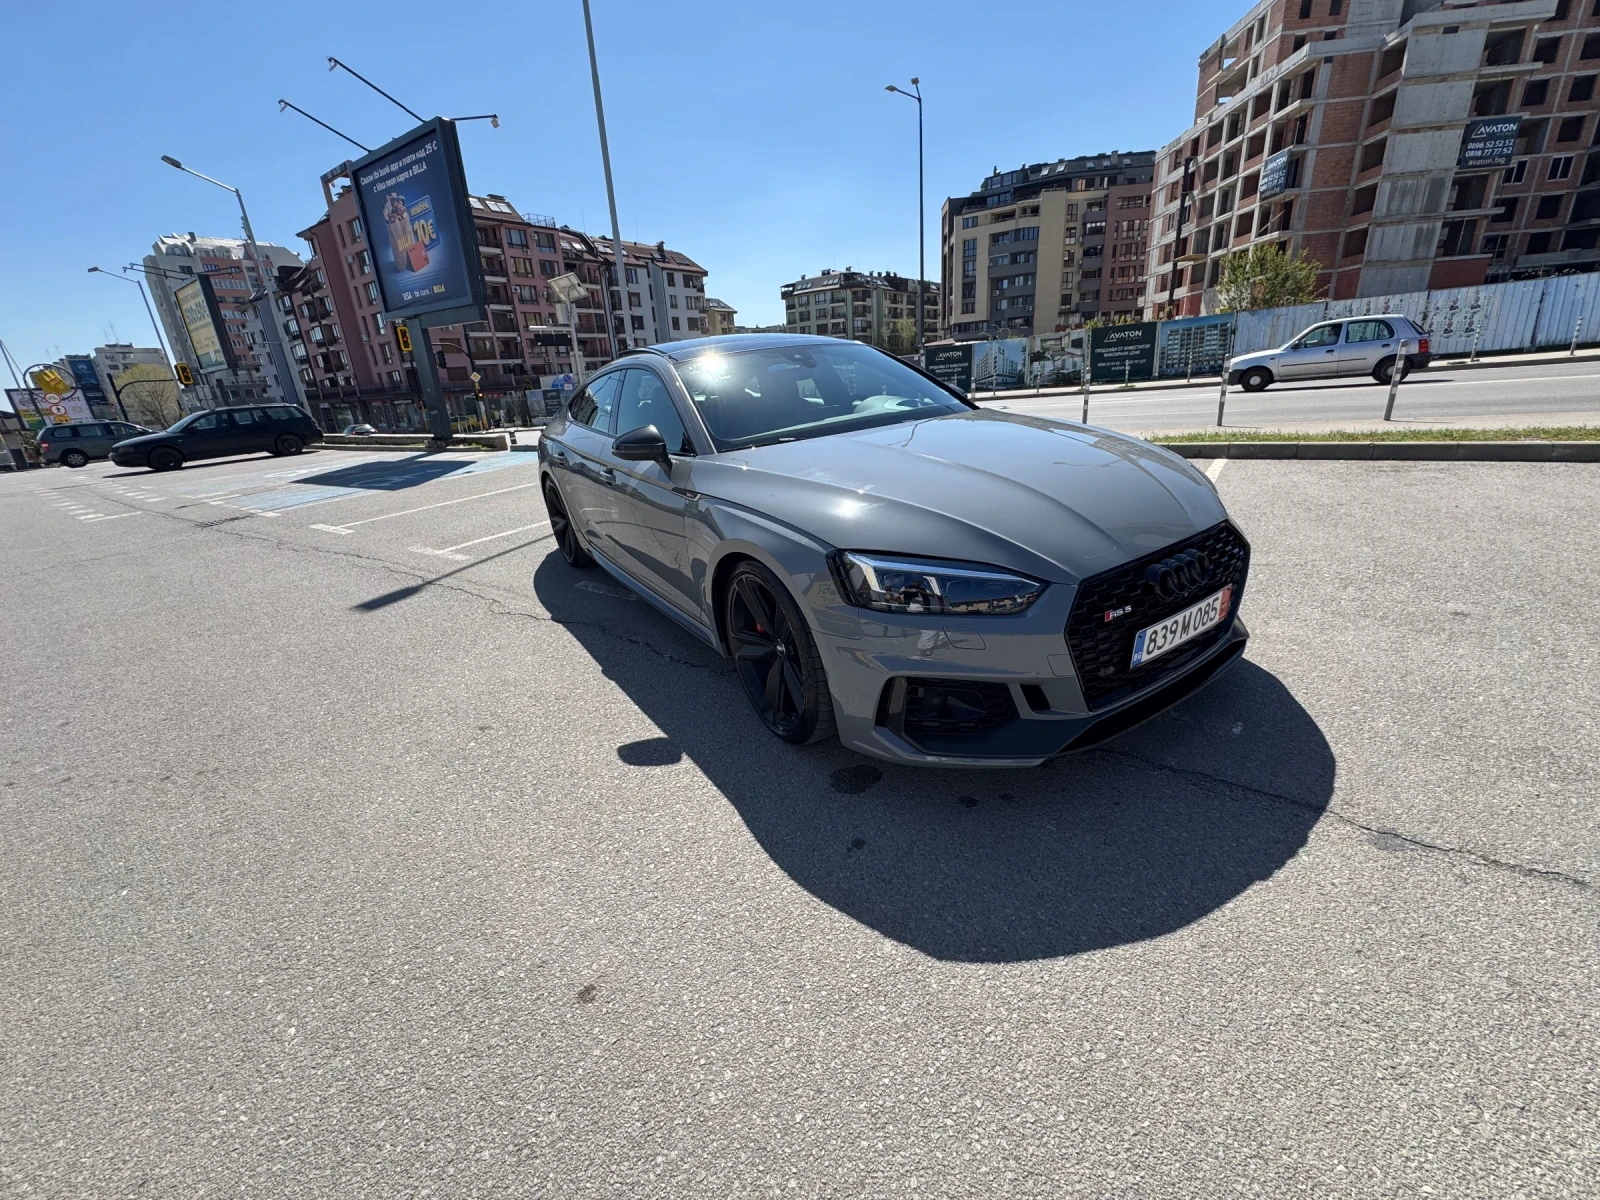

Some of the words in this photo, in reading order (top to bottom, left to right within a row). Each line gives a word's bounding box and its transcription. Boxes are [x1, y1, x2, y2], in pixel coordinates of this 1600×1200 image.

[1476, 122, 1518, 134] AVATON
[379, 165, 390, 177] bank
[390, 162, 398, 172] app
[425, 143, 432, 154] 25
[433, 140, 438, 150] €
[1468, 156, 1505, 166] avaton.bg
[376, 182, 386, 191] Visa
[412, 161, 427, 175] BILLA
[414, 219, 436, 245] 10€
[398, 234, 413, 251] BILLA
[402, 290, 412, 300] VISA
[433, 284, 445, 294] BILLA
[1108, 330, 1142, 340] AVATON
[1146, 619, 1179, 655] 839
[1180, 611, 1192, 639] M
[1193, 597, 1219, 632] 085
[1134, 652, 1142, 661] BG
